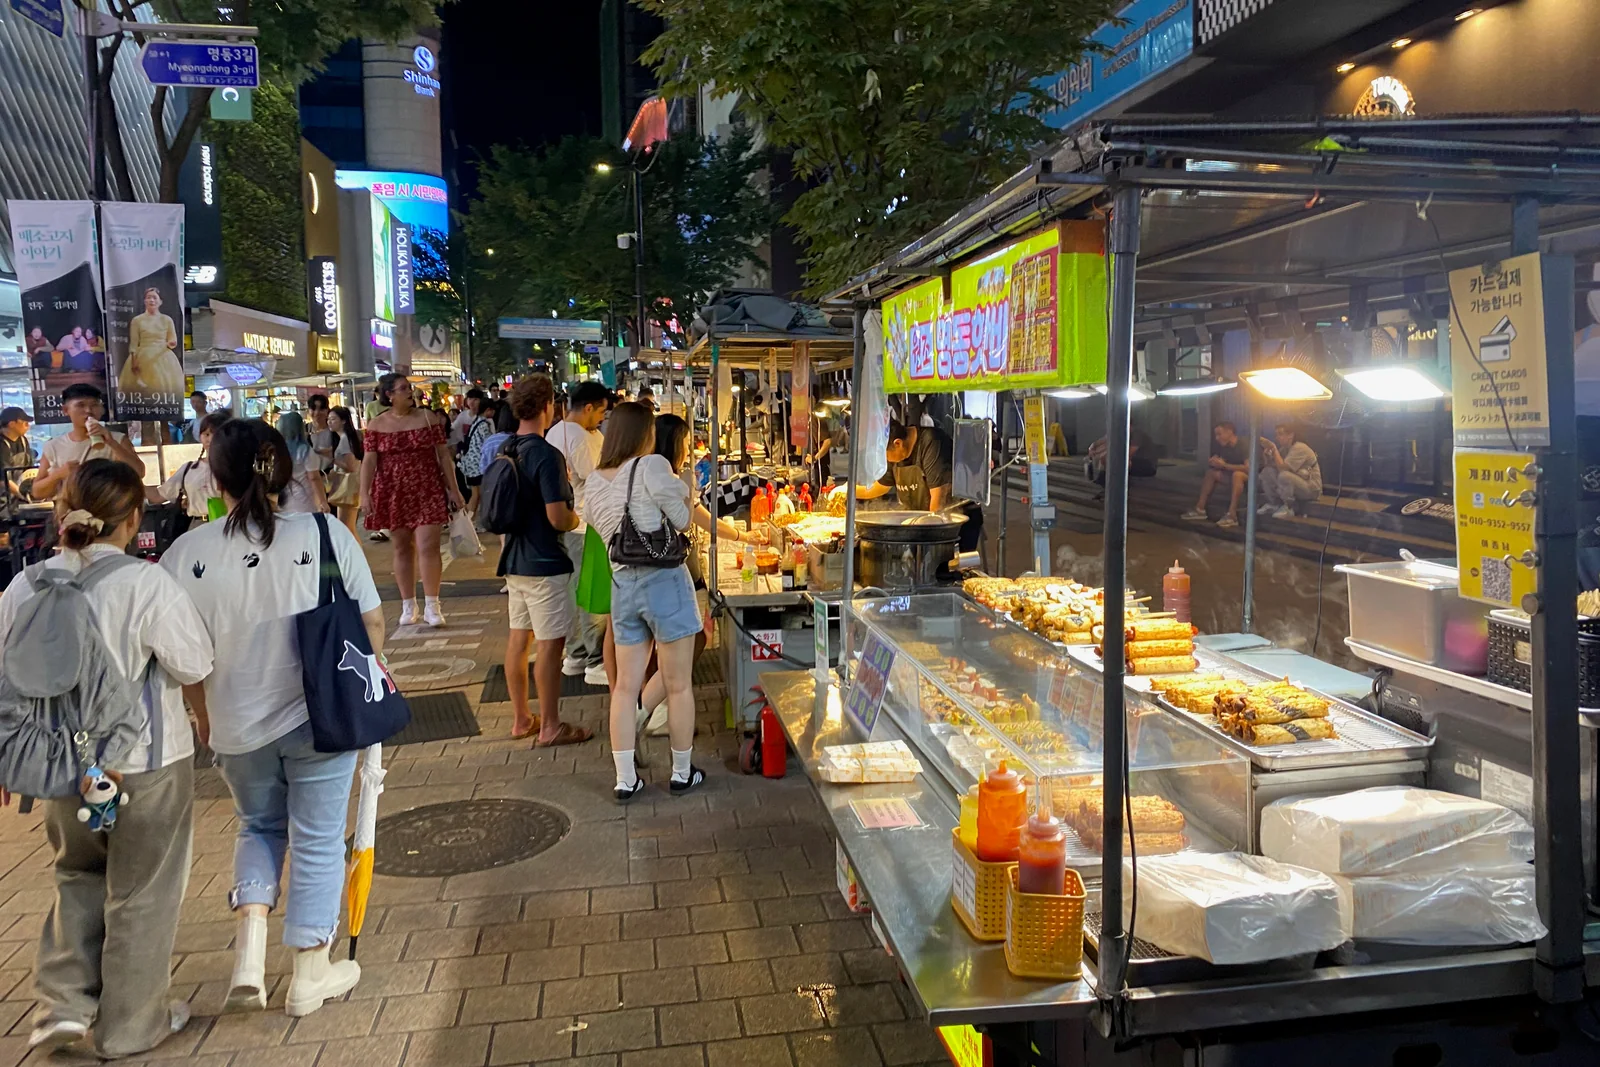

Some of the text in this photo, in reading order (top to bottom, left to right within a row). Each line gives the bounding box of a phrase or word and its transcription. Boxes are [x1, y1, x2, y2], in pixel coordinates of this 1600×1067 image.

[207, 46, 254, 63] 명동3길
[168, 62, 254, 76] Myeongdong 3-gil
[403, 69, 440, 90] Shinhan
[414, 83, 435, 97] Bank
[201, 145, 213, 205] new balance
[372, 183, 395, 197] 폭염
[397, 183, 409, 197] 시
[18, 229, 74, 244] 배소고지
[147, 237, 171, 252] 바다
[21, 245, 62, 259] 이야기
[396, 227, 410, 308] HOLIKA HOLIKA
[1470, 268, 1521, 294] 카드결제
[322, 261, 336, 330] SKINFOOD
[1470, 292, 1522, 314] 가능합니다
[243, 332, 296, 358] NATURE REPUBLIC
[1500, 368, 1527, 380] CARDS
[1469, 515, 1531, 533] 010-9352-9557
[755, 632, 778, 642] 소화기
